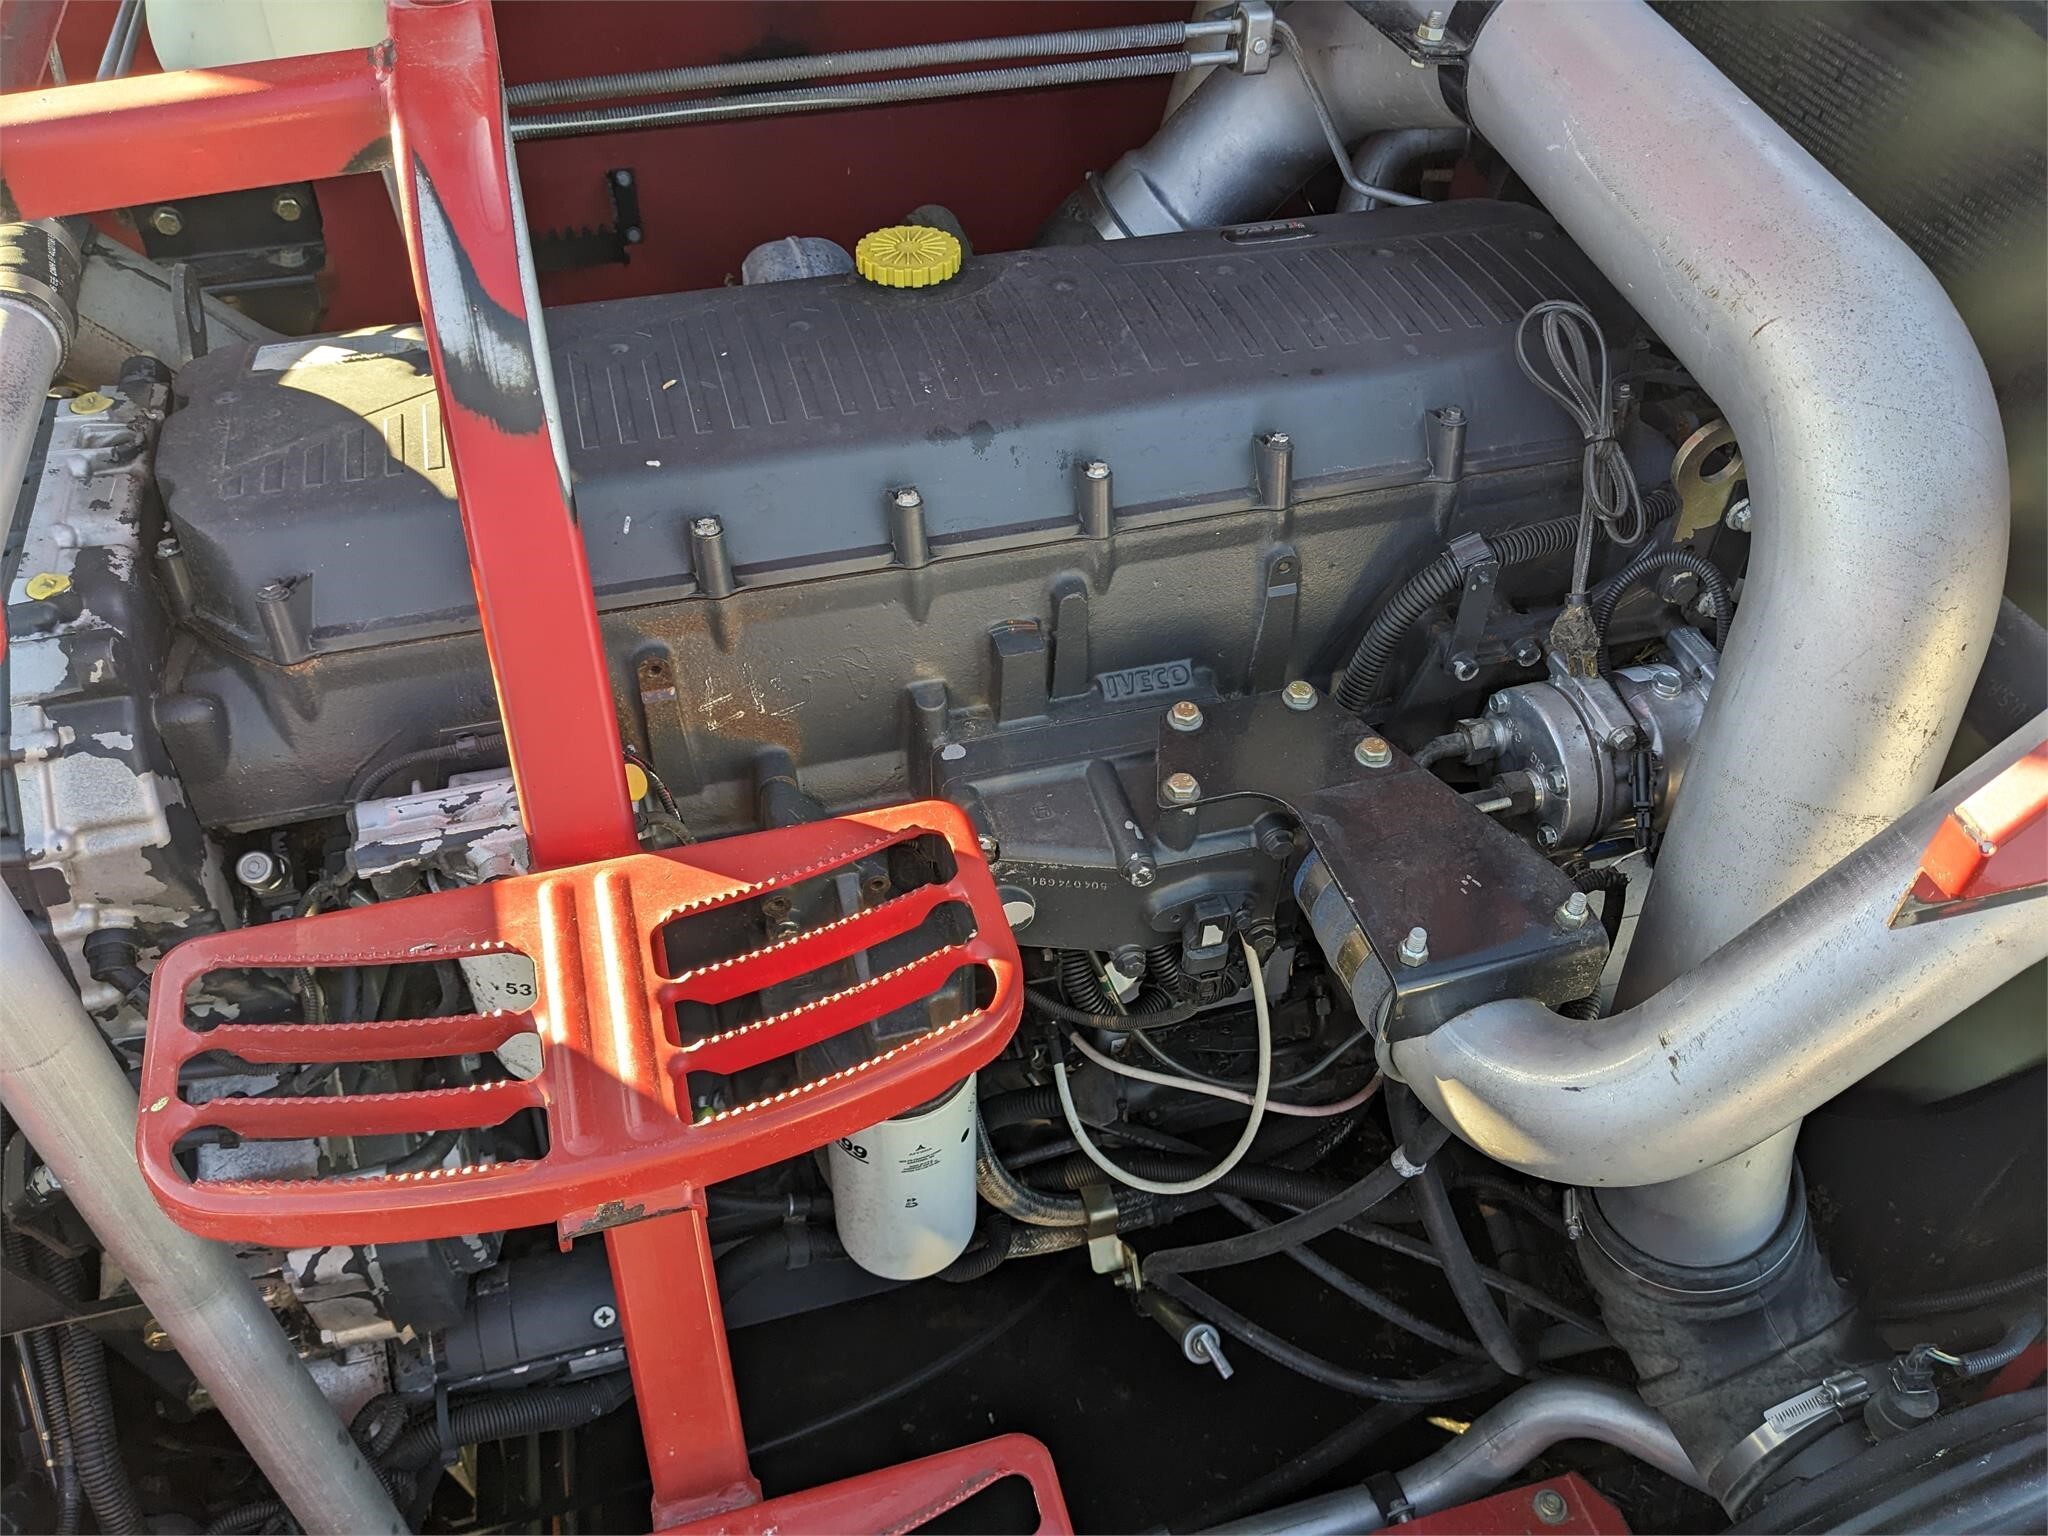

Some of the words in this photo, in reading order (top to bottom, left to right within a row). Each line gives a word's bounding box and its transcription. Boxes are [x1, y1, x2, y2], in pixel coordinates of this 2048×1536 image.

[1104, 664, 1190, 698] IVECO
[505, 982, 533, 997] 53
[835, 1137, 867, 1159] 99
